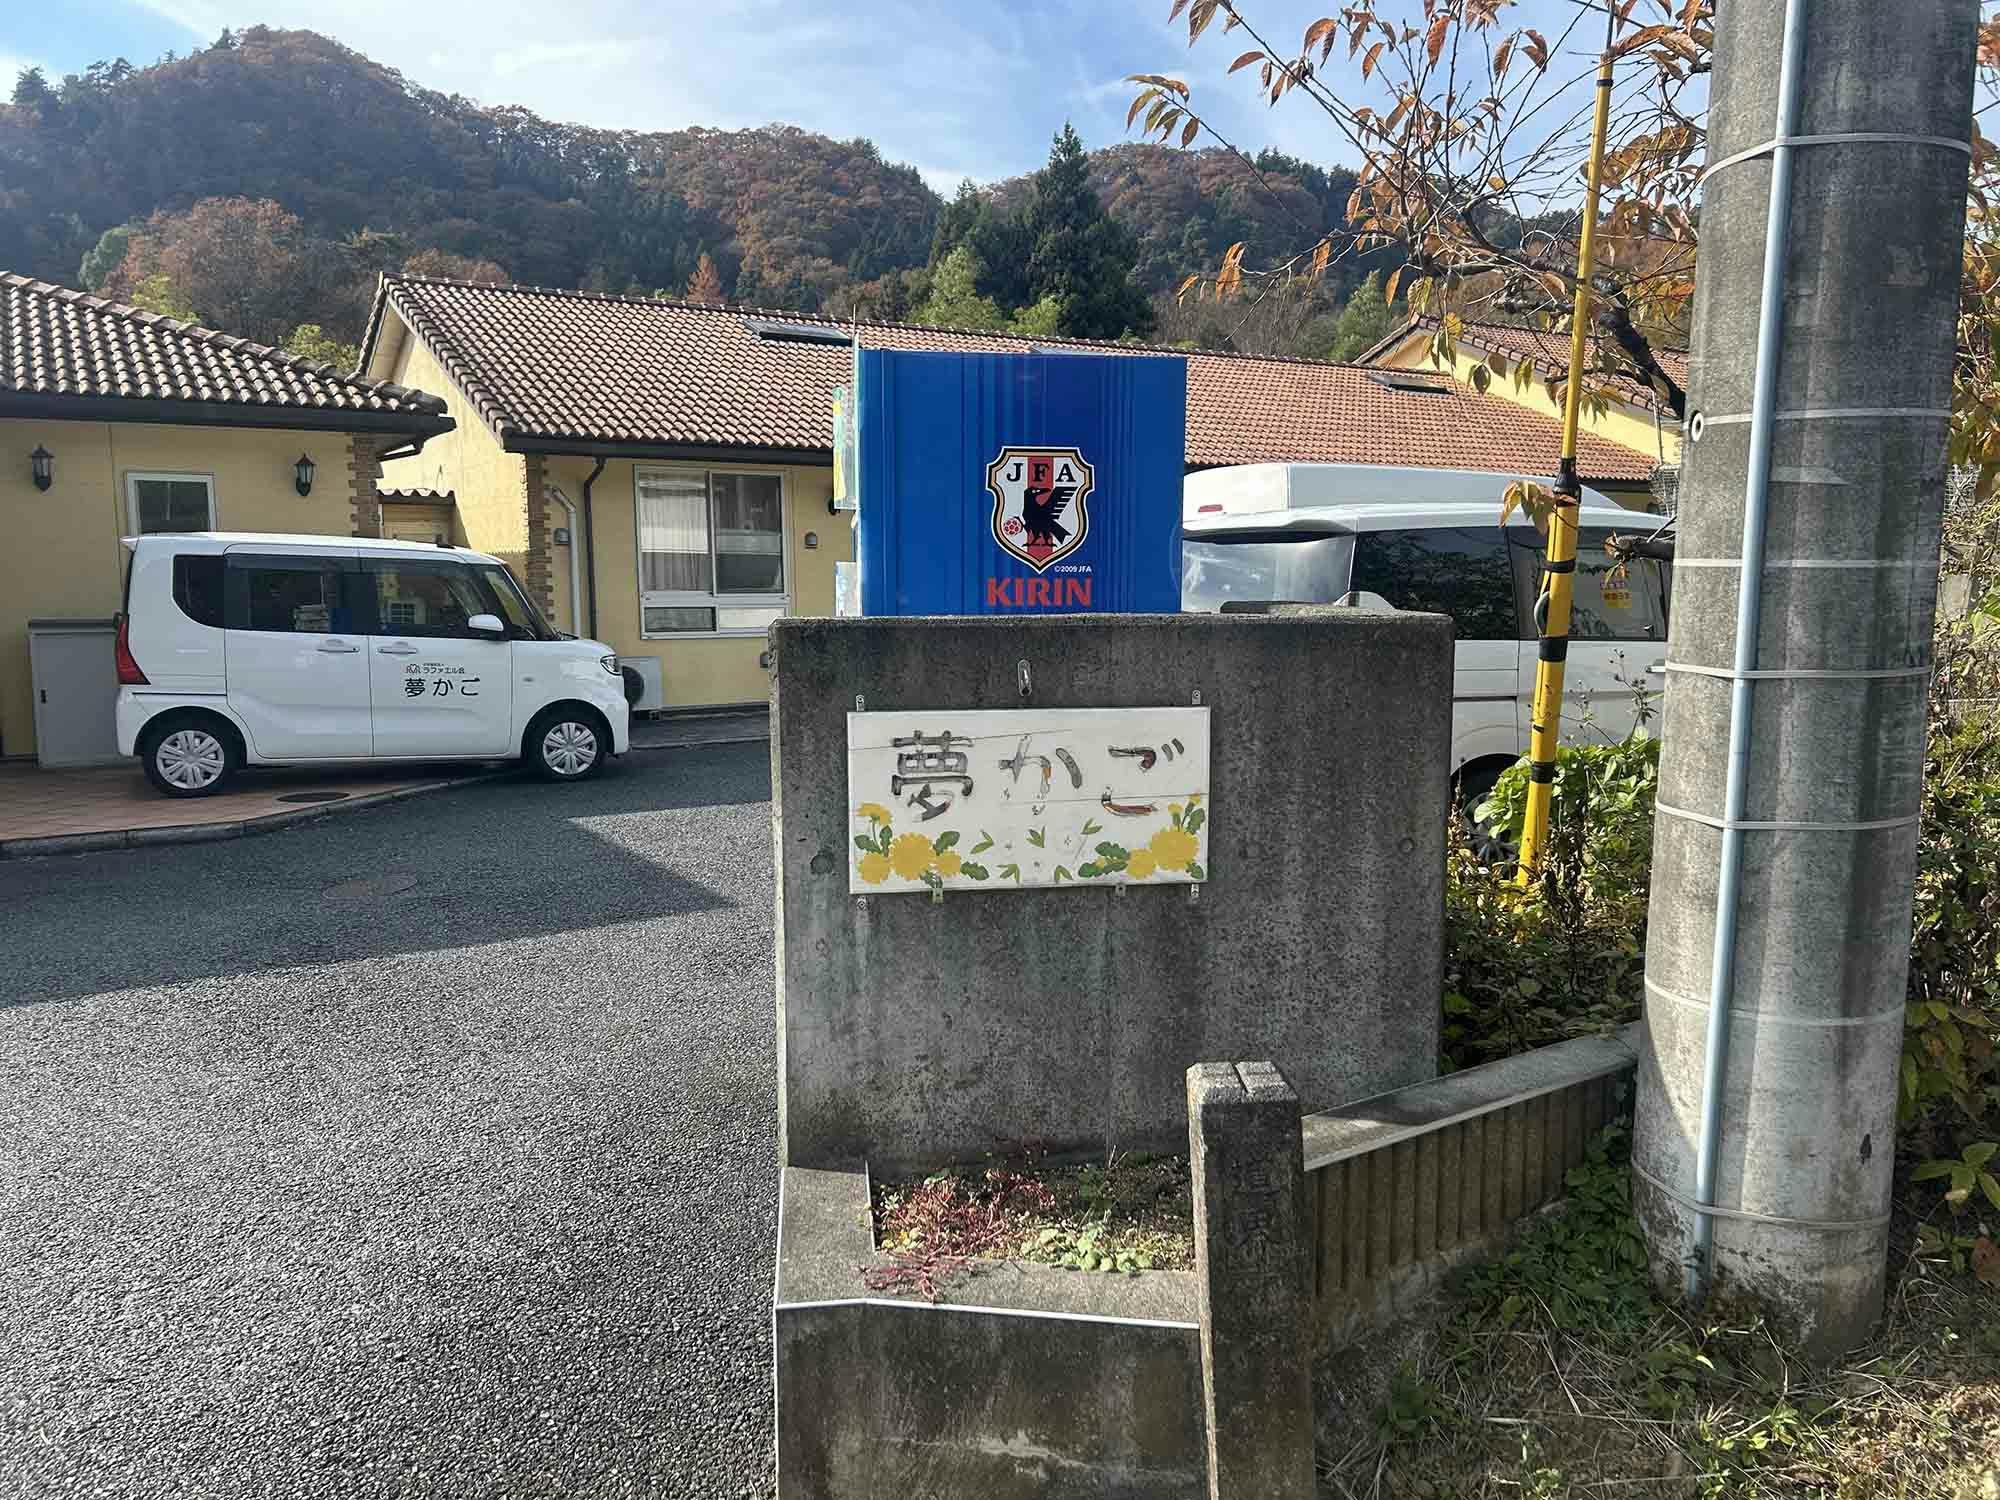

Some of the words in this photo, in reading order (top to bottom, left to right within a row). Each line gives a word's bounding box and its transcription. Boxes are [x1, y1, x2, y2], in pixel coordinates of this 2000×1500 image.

[1006, 462, 1077, 483] JFA
[1078, 565, 1092, 573] JFA
[987, 577, 1092, 608] KIRIN
[404, 677, 481, 698] 夢かご
[890, 729, 1185, 824] 夢かご
